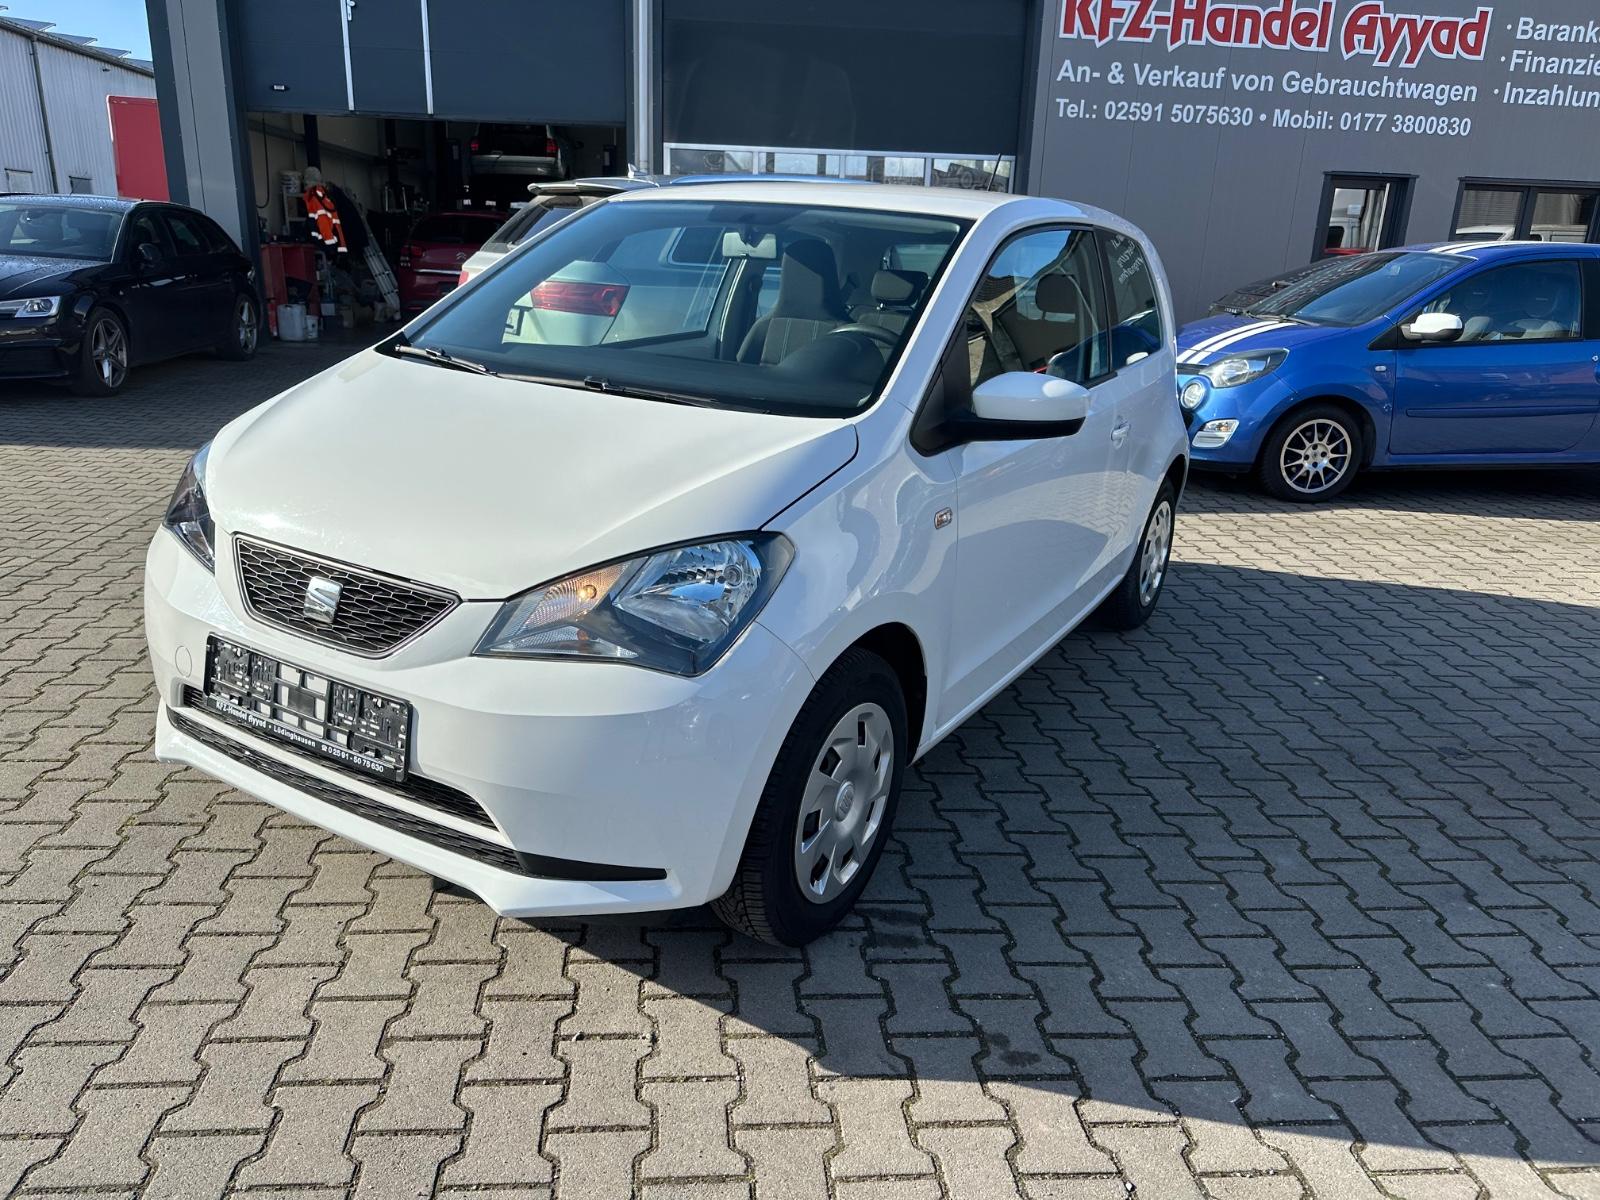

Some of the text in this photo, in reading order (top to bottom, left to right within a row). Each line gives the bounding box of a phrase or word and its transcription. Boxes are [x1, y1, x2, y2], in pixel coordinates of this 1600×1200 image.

[1340, 1, 1493, 68] Ayyad
[1516, 17, 1600, 43] Barank
[1057, 59, 1478, 106] An- & Verkauf von Gebrauchtwagen
[1502, 82, 1600, 108] Inzahlun
[1056, 98, 1098, 119] Tel.:
[1104, 101, 1162, 122] 02591
[1170, 104, 1253, 126] 5075630
[1340, 112, 1387, 132] 0177
[1391, 114, 1472, 136] 3800830
